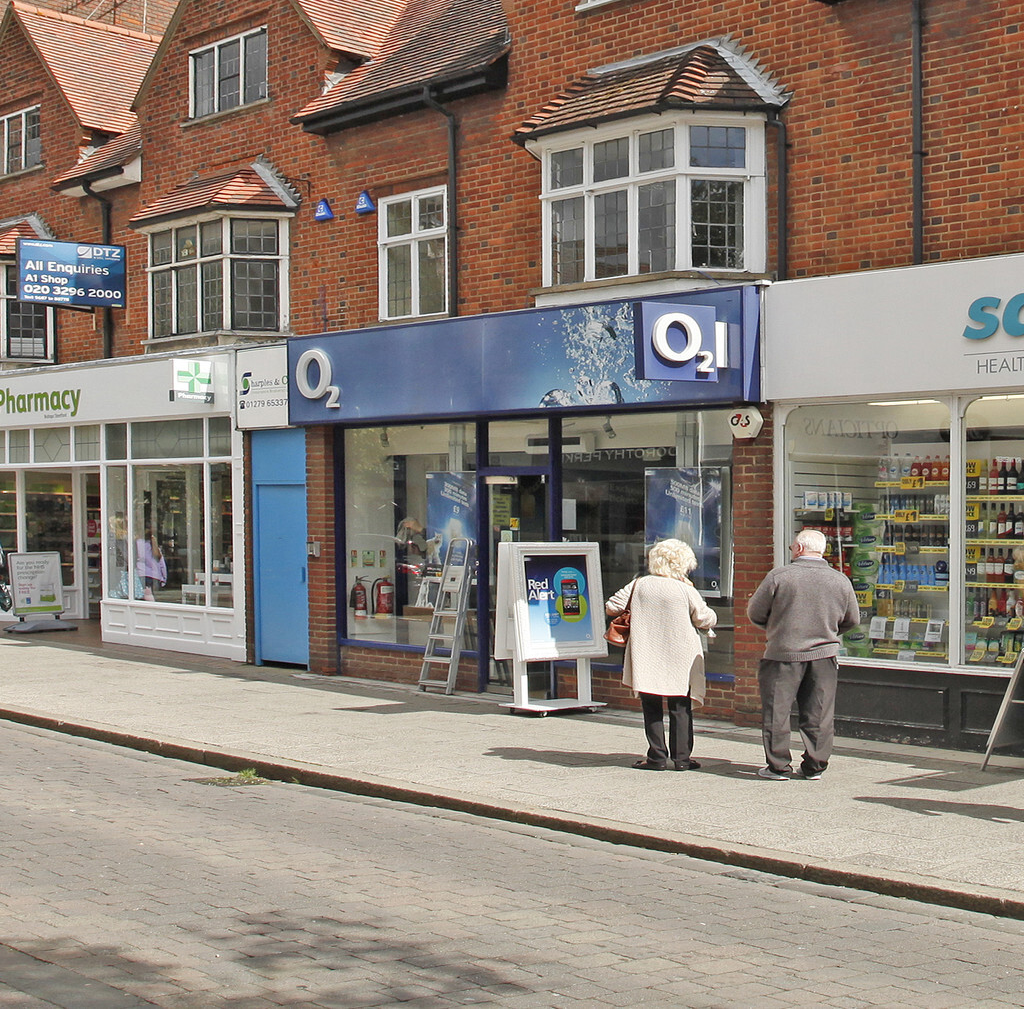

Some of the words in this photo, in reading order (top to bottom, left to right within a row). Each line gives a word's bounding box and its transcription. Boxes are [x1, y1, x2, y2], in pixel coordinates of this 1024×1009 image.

[94, 247, 120, 258] DTZ
[25, 260, 43, 271] All
[47, 261, 110, 276] Enquiries
[25, 273, 38, 282] A1
[41, 275, 68, 285] Shop
[24, 284, 50, 294] 020
[52, 286, 85, 297] 3296
[88, 289, 121, 299] 2000
[296, 349, 340, 408] O2
[178, 392, 211, 401] Pharmacy
[0, 388, 81, 417] Pharmacy
[246, 400, 265, 408] 01279
[528, 578, 548, 589] Red
[528, 590, 555, 600] Alert
